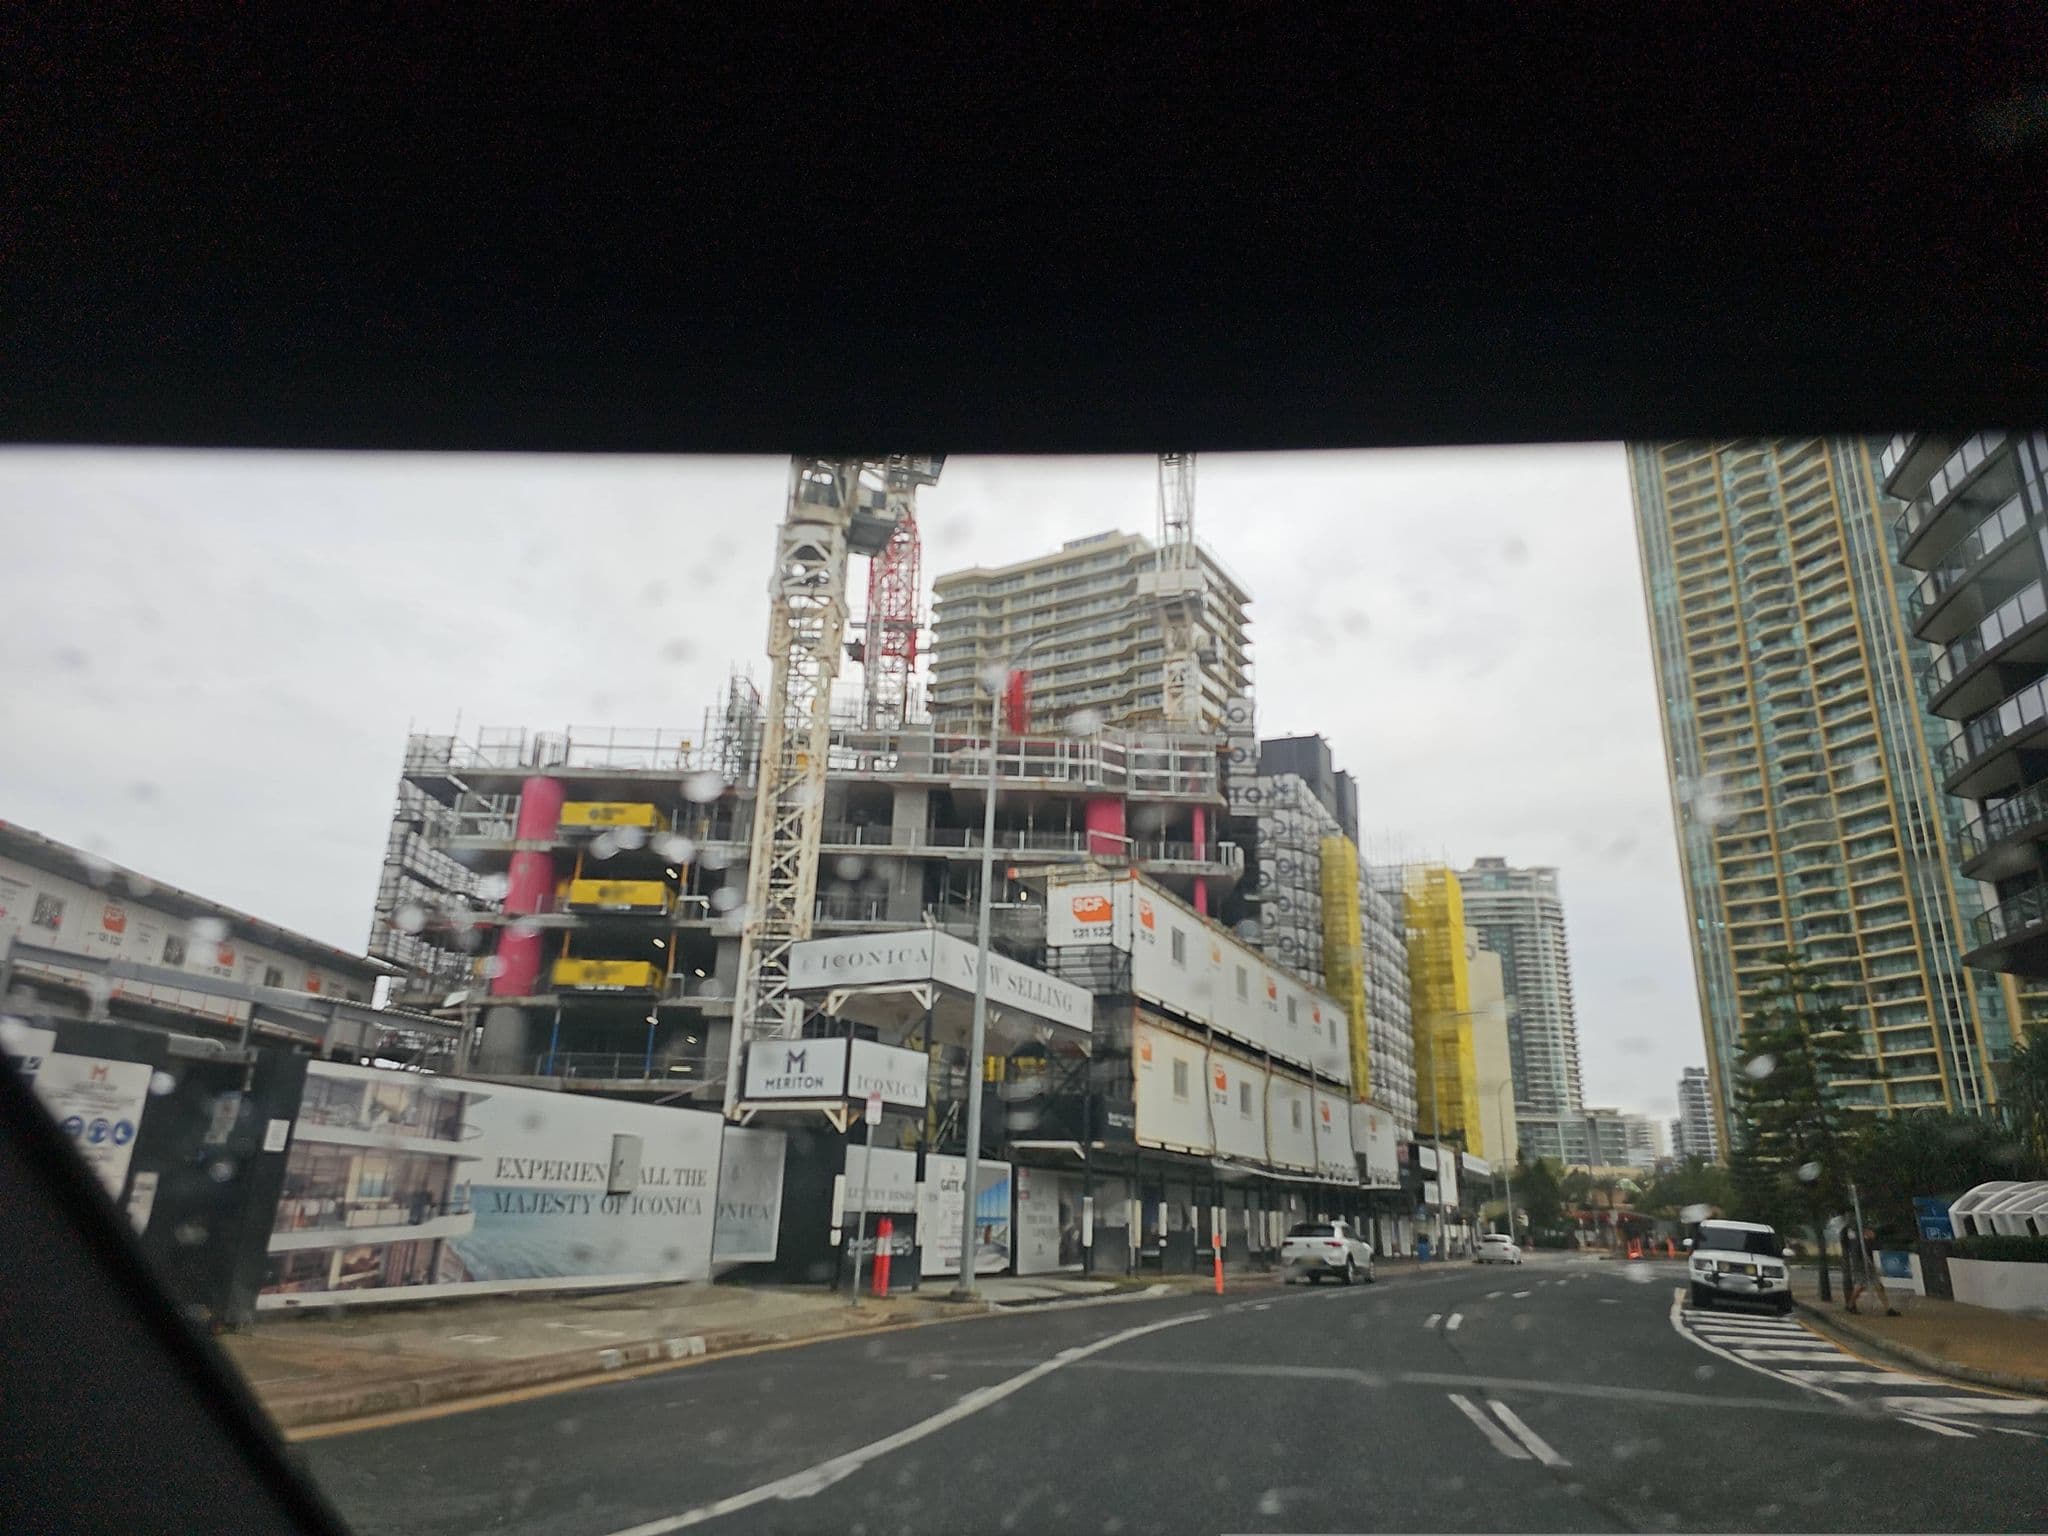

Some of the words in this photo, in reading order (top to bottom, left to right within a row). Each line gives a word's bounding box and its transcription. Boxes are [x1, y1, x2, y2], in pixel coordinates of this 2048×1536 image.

[821, 948, 928, 970] ICONICA
[962, 954, 1006, 984] NW
[1008, 974, 1073, 1012] SELLING
[765, 1076, 824, 1091] MERITON
[857, 1074, 919, 1099] ICONICA
[495, 1156, 609, 1184] EXPERIEN
[675, 1167, 708, 1188] THE
[491, 1192, 596, 1215] MAJESTY
[601, 1193, 628, 1215] OF
[631, 1196, 703, 1217] ICONICA
